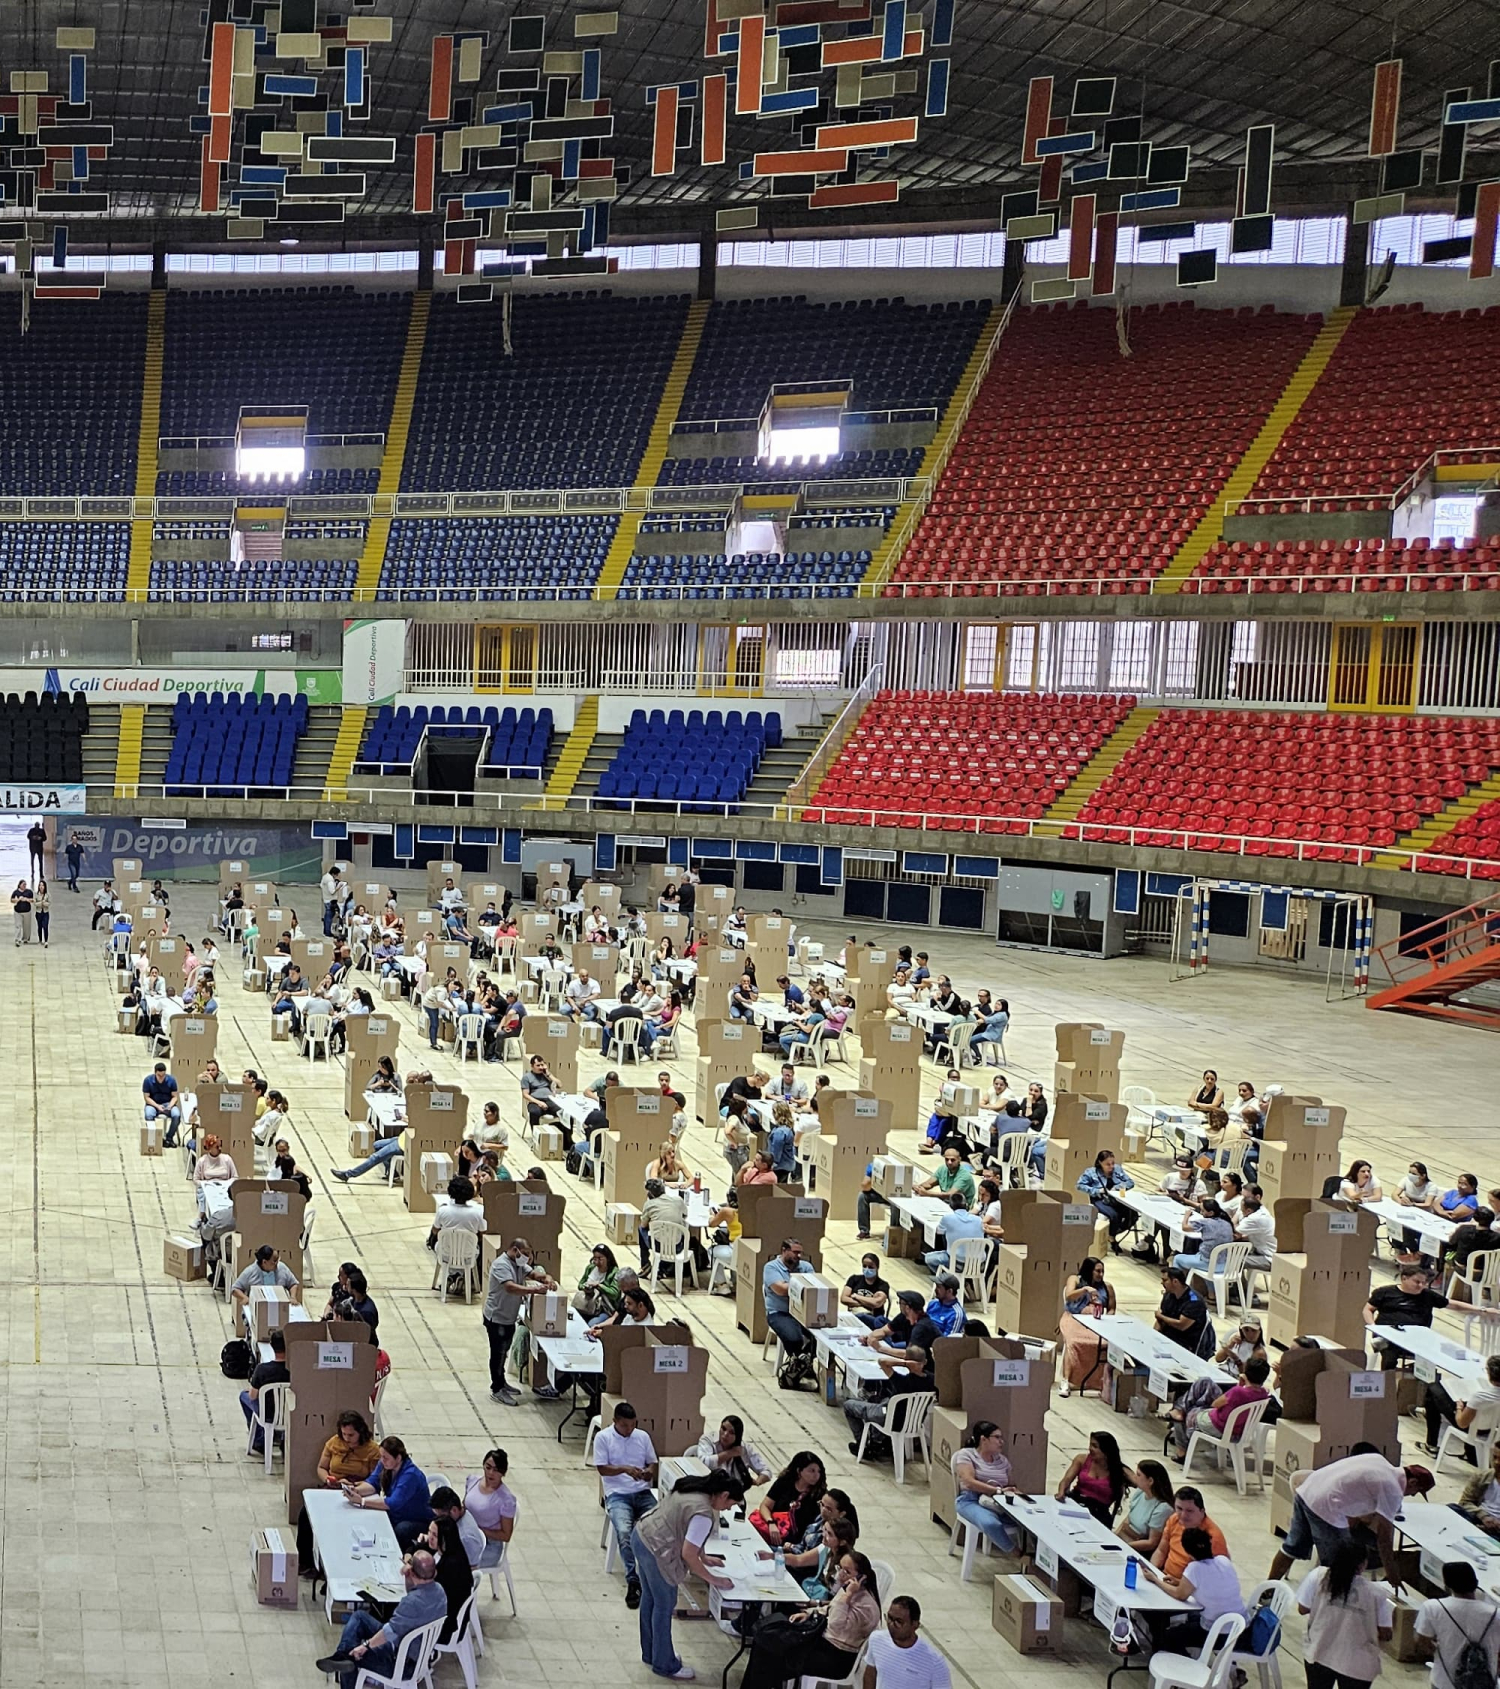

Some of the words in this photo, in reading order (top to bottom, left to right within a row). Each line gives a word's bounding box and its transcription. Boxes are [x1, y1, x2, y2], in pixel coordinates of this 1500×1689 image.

[369, 626, 377, 661] Deportiva
[368, 662, 376, 687] Ciudad
[69, 677, 100, 691] Cali
[103, 678, 160, 691] Ciudad
[163, 678, 244, 693] Deportiva
[111, 829, 258, 859] Deportiva
[659, 1360, 676, 1368] MESA
[998, 1373, 1017, 1381] MESA
[1354, 1385, 1373, 1393] MESA
[1039, 1555, 1050, 1569] MESA
